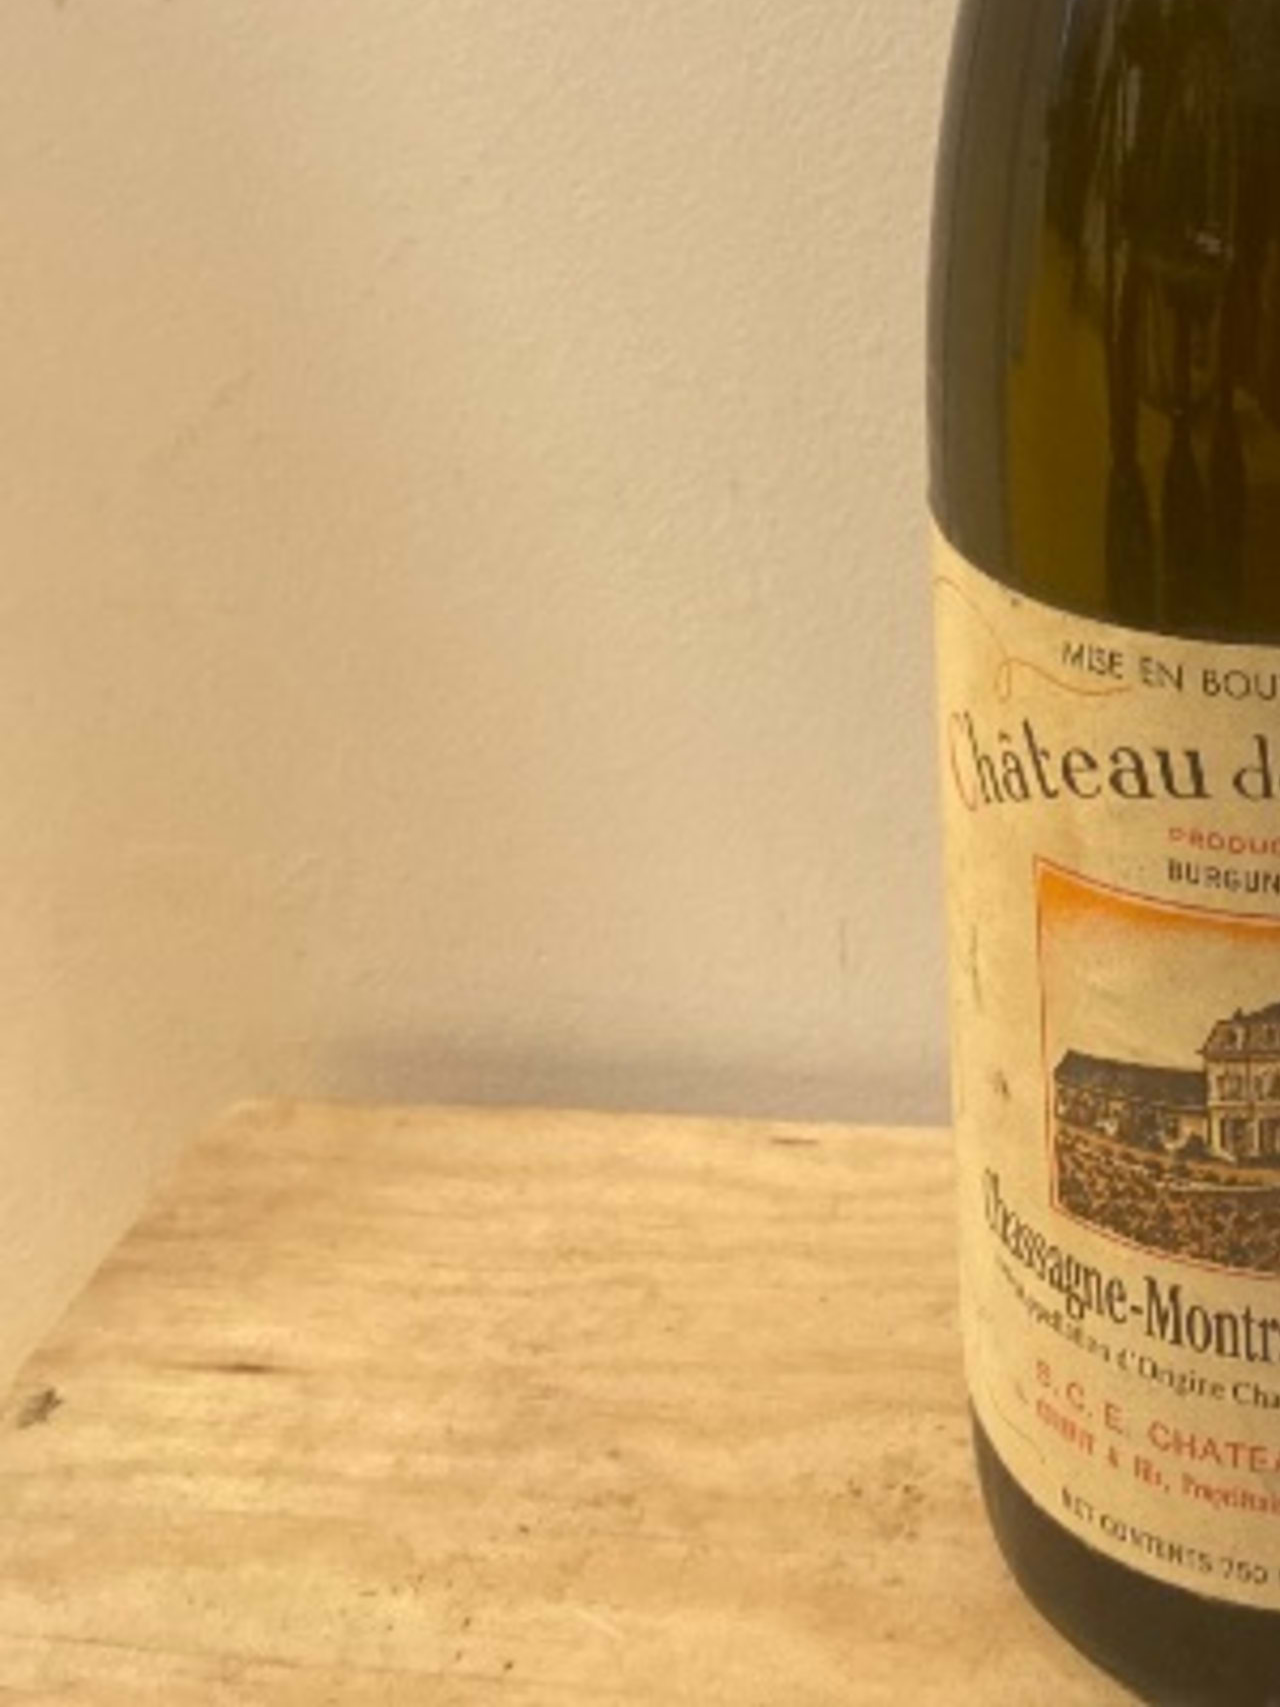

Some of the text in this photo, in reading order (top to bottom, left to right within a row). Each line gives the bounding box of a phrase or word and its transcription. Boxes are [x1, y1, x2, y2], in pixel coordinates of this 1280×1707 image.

[1061, 639, 1125, 681] MISE
[1138, 655, 1185, 693] EN
[948, 709, 1211, 813] Château
